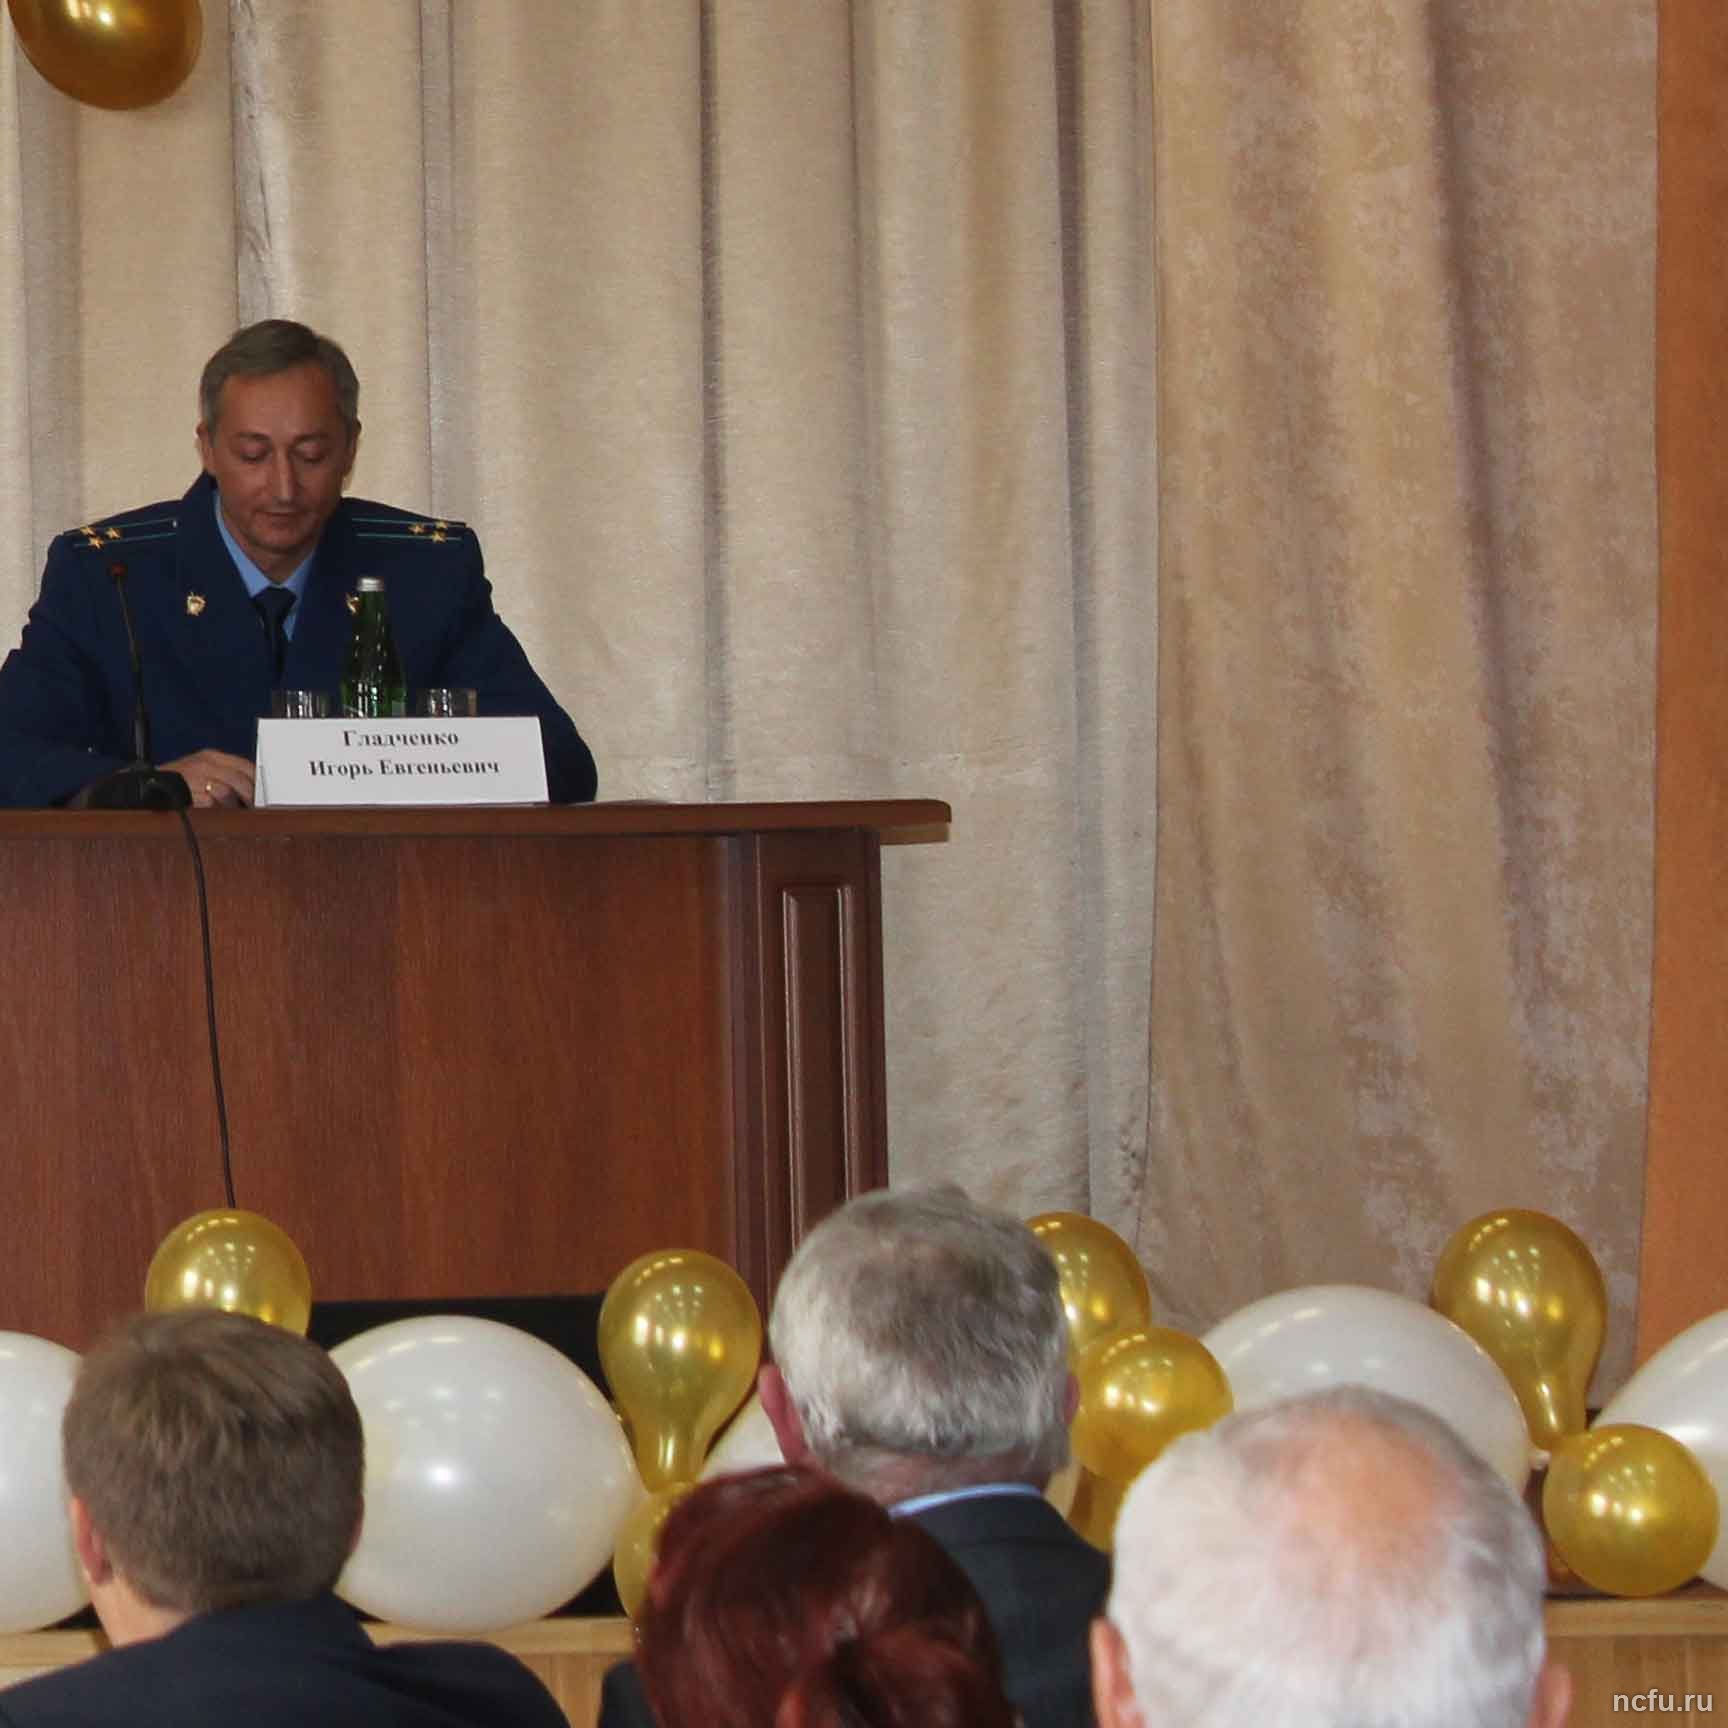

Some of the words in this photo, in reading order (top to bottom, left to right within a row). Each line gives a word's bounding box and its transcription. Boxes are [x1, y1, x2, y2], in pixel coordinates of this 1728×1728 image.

[343, 729, 460, 749] Гладченко
[308, 759, 374, 781] Игорь
[379, 758, 501, 776] Евгеньевич
